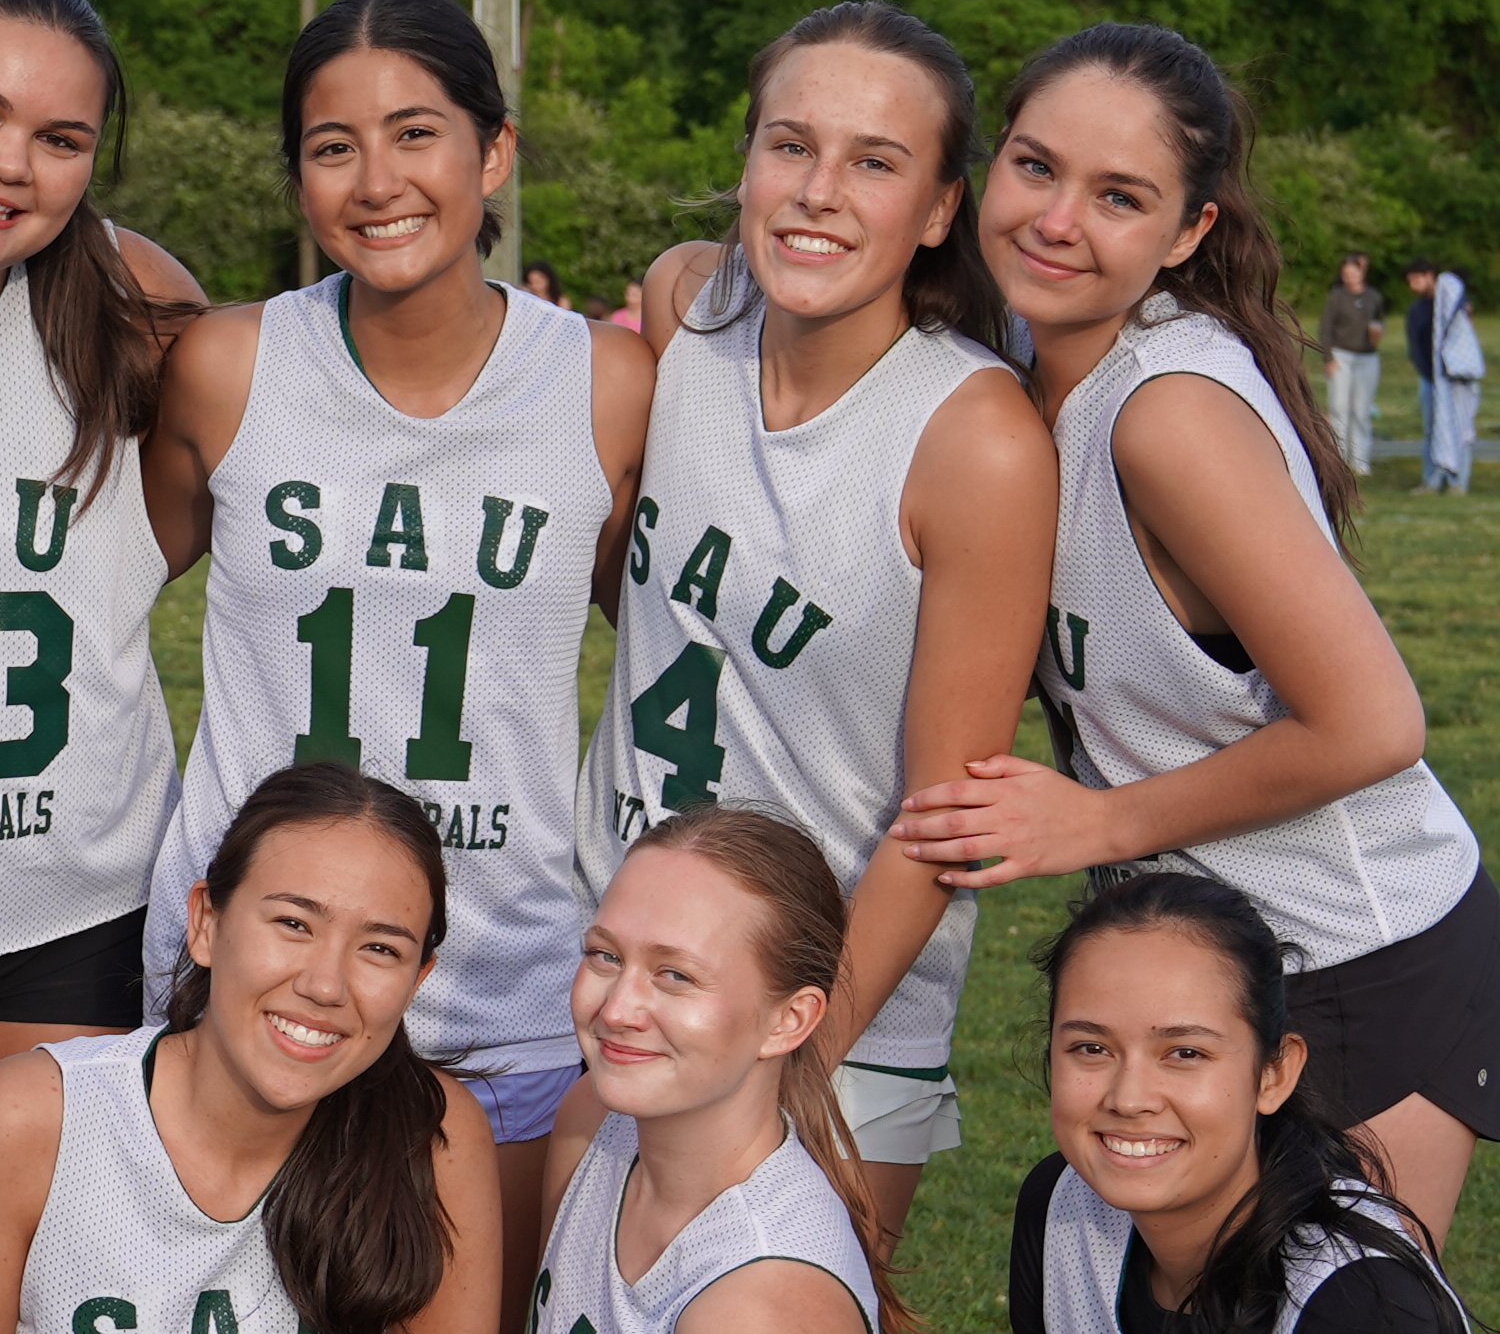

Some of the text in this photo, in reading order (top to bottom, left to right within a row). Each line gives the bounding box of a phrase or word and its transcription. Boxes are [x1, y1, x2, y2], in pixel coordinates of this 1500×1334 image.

[265, 480, 550, 589] SAU
[629, 496, 834, 669] SAU
[294, 586, 476, 781] 11
[630, 640, 730, 813] 4
